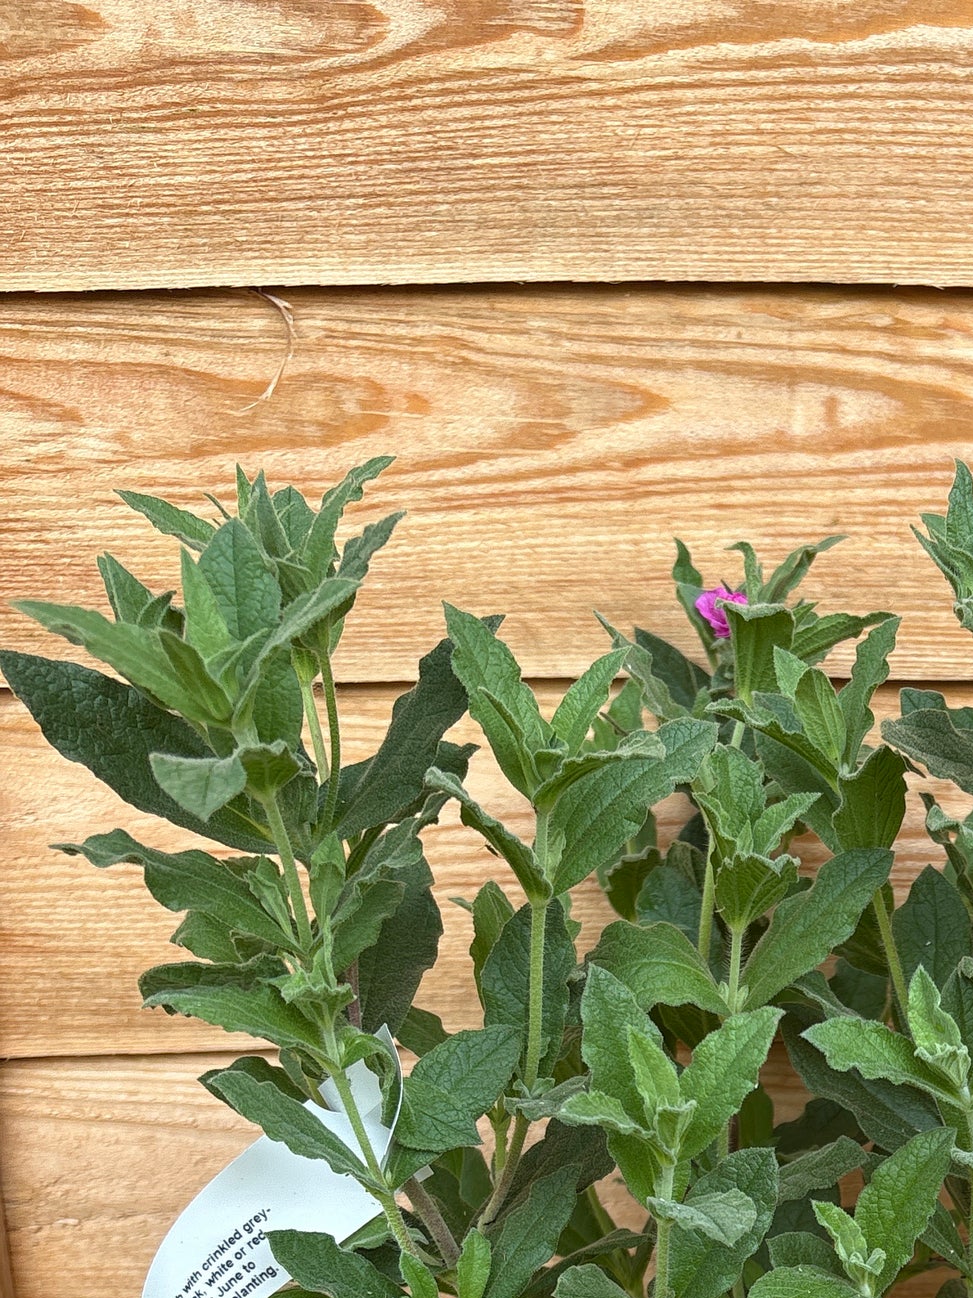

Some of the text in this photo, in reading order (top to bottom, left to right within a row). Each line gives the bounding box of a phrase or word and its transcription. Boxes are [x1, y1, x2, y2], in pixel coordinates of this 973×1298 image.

[183, 1270, 203, 1294] with
[201, 1229, 243, 1271] crinkled
[243, 1208, 271, 1235] grey-
[205, 1259, 235, 1288] white
[234, 1247, 247, 1260] or
[247, 1229, 266, 1250] red
[217, 1272, 245, 1298] June
[242, 1260, 257, 1273] to
